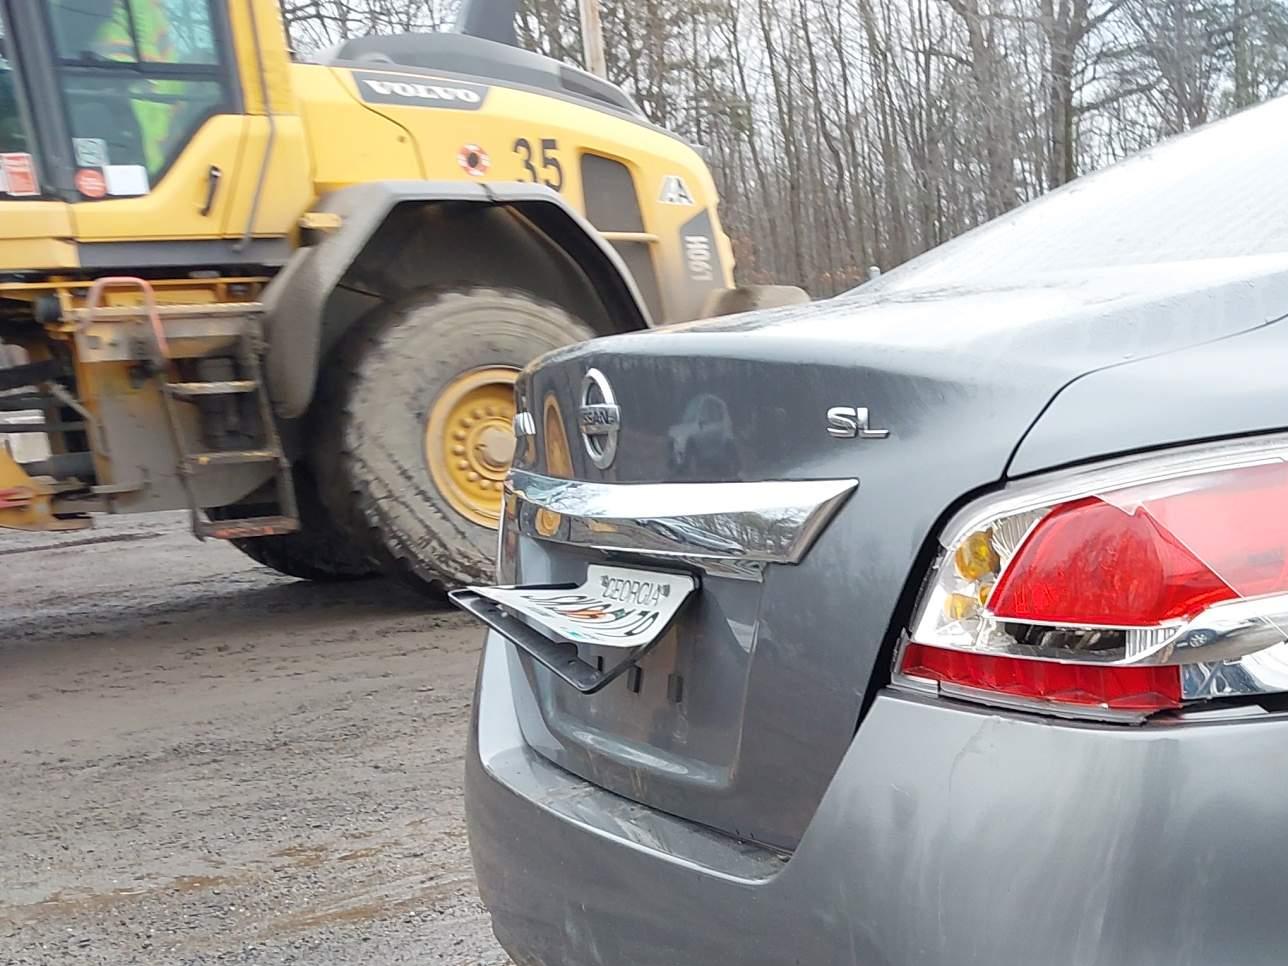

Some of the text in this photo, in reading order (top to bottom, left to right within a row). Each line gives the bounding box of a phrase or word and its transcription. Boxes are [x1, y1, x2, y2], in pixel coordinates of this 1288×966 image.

[361, 79, 481, 103] VOLVO
[511, 137, 563, 192] 35
[684, 235, 713, 281] L90H
[826, 406, 890, 438] SL
[602, 577, 662, 607] GEORGIA
